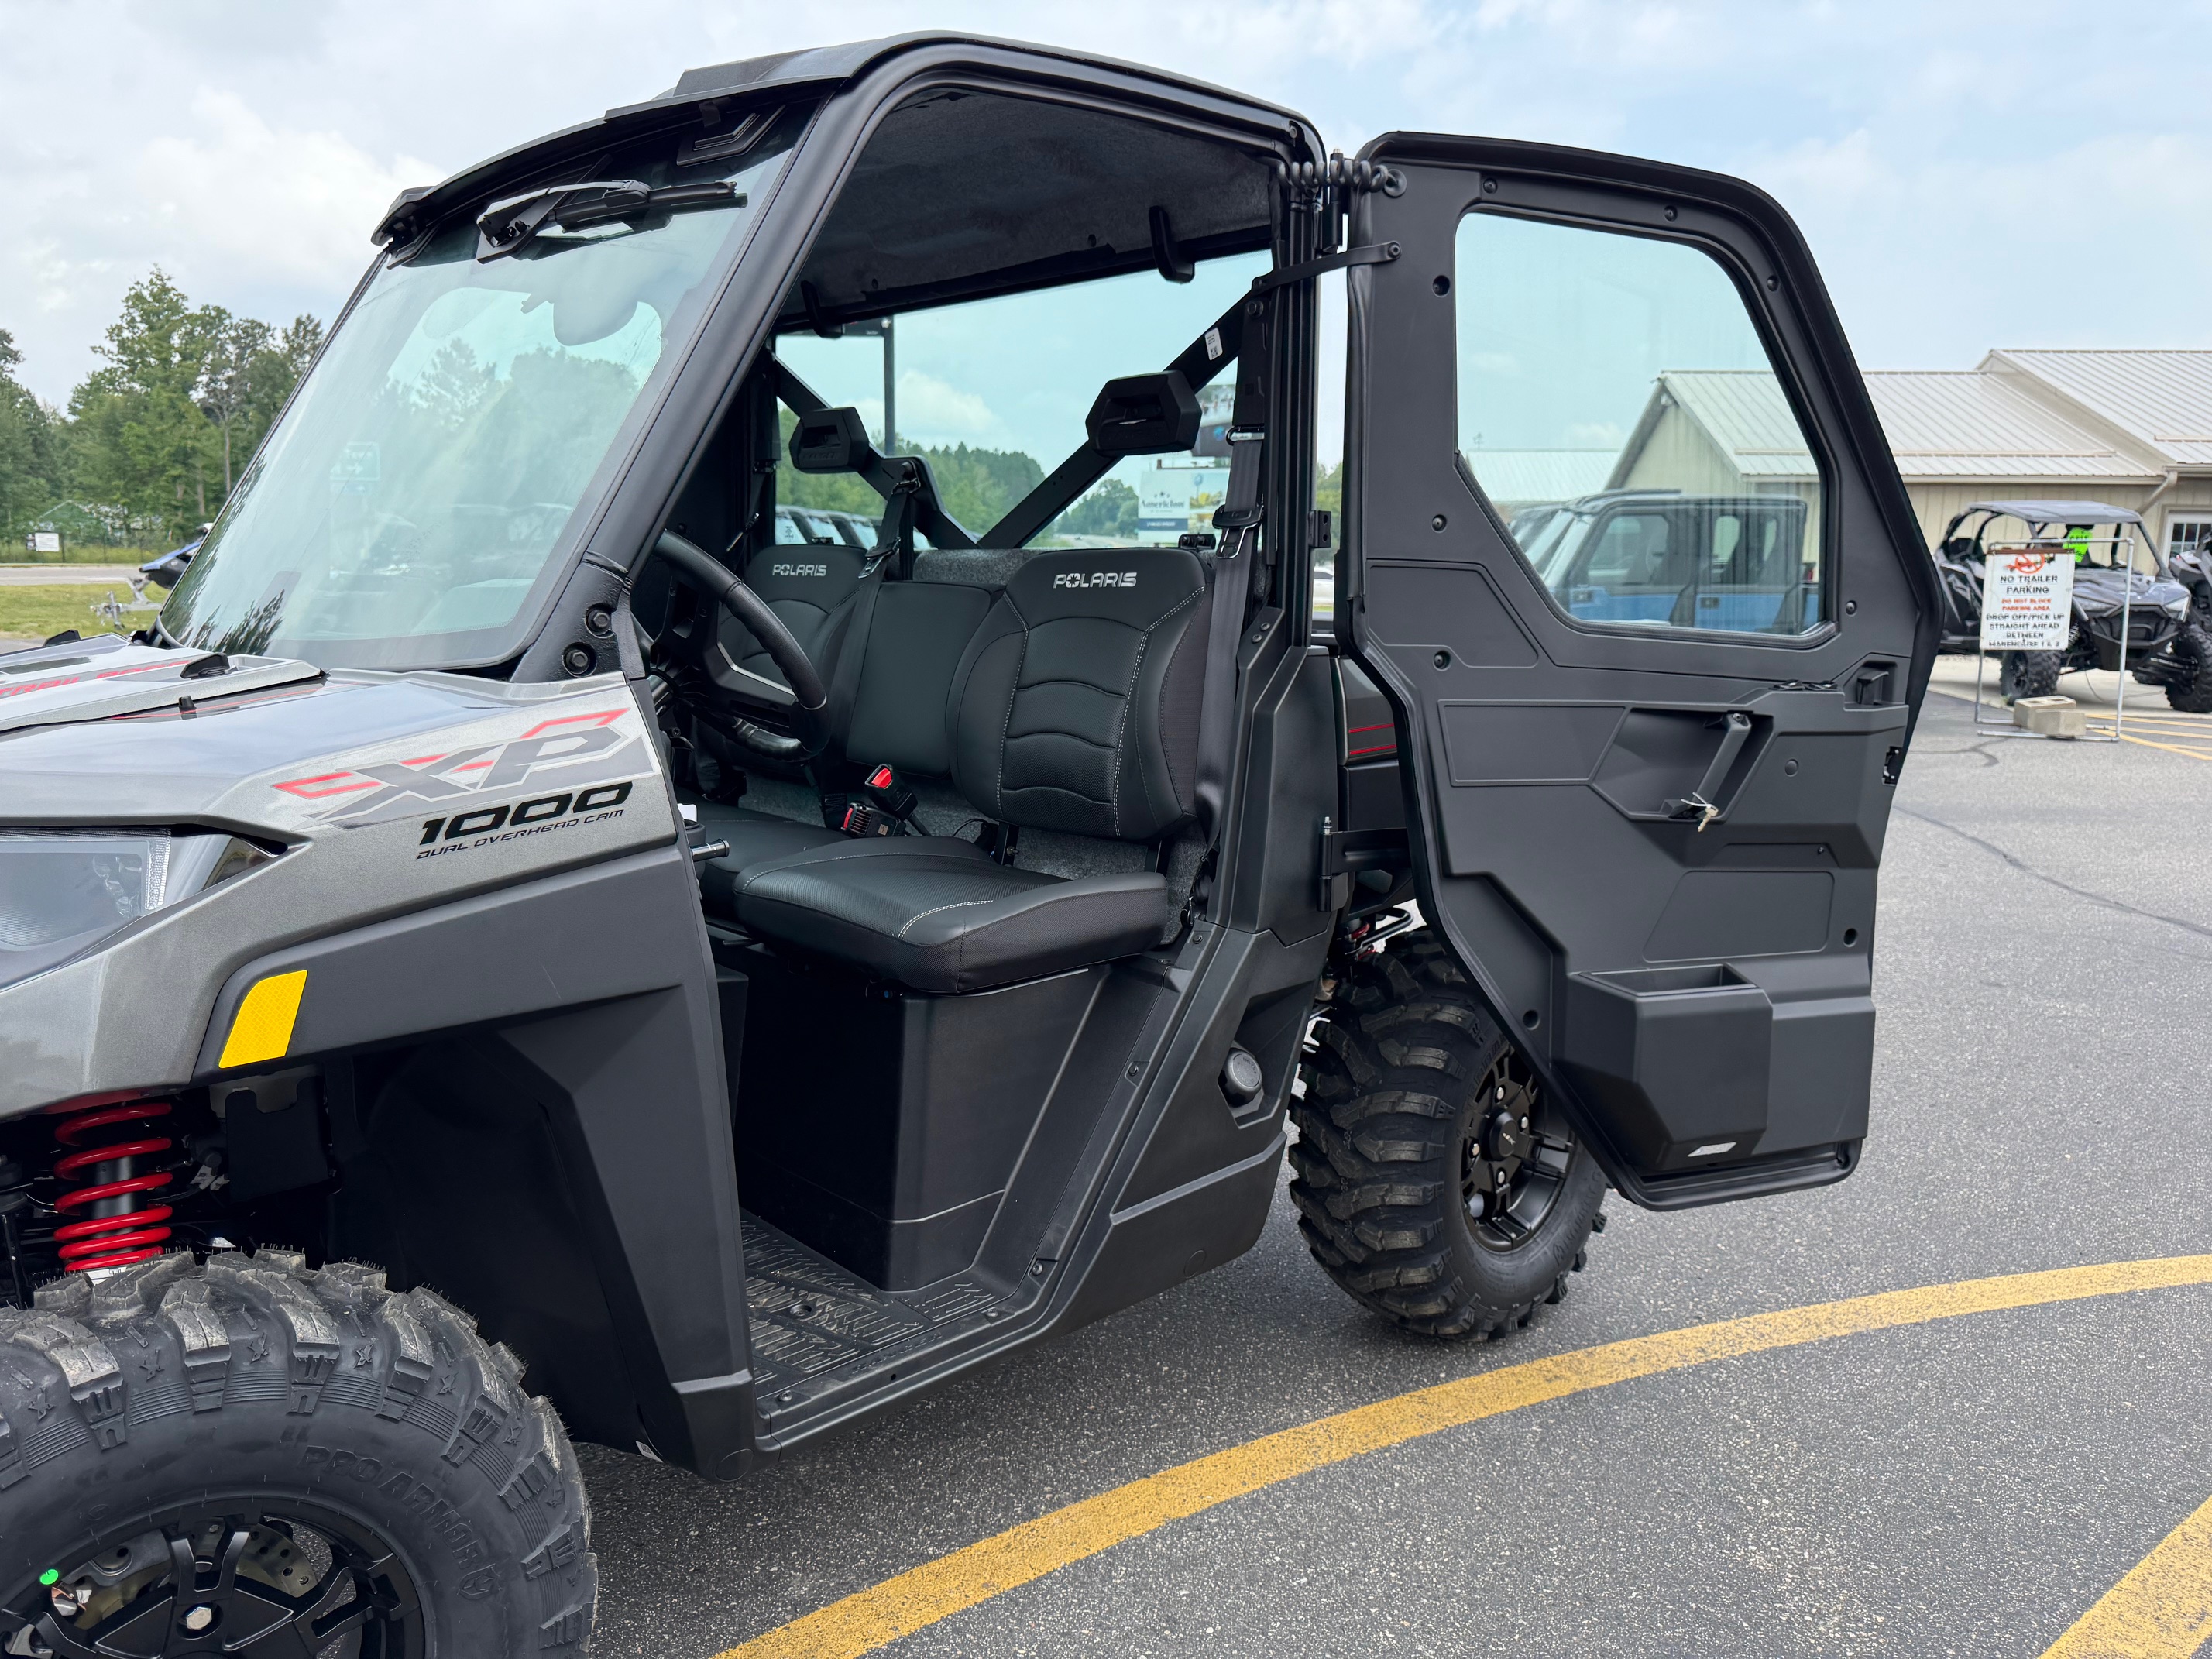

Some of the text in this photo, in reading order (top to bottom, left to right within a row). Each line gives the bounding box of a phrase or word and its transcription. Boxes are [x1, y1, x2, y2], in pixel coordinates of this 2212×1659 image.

[772, 564, 827, 577] POLARIS
[1053, 572, 1137, 589] POLARIS
[2000, 575, 2058, 584] NO TRAILER
[2006, 586, 2050, 594] PARKING
[316, 725, 624, 821] XP
[419, 781, 633, 846] 1000
[416, 809, 625, 860] DUAL OVERHEAD CAM
